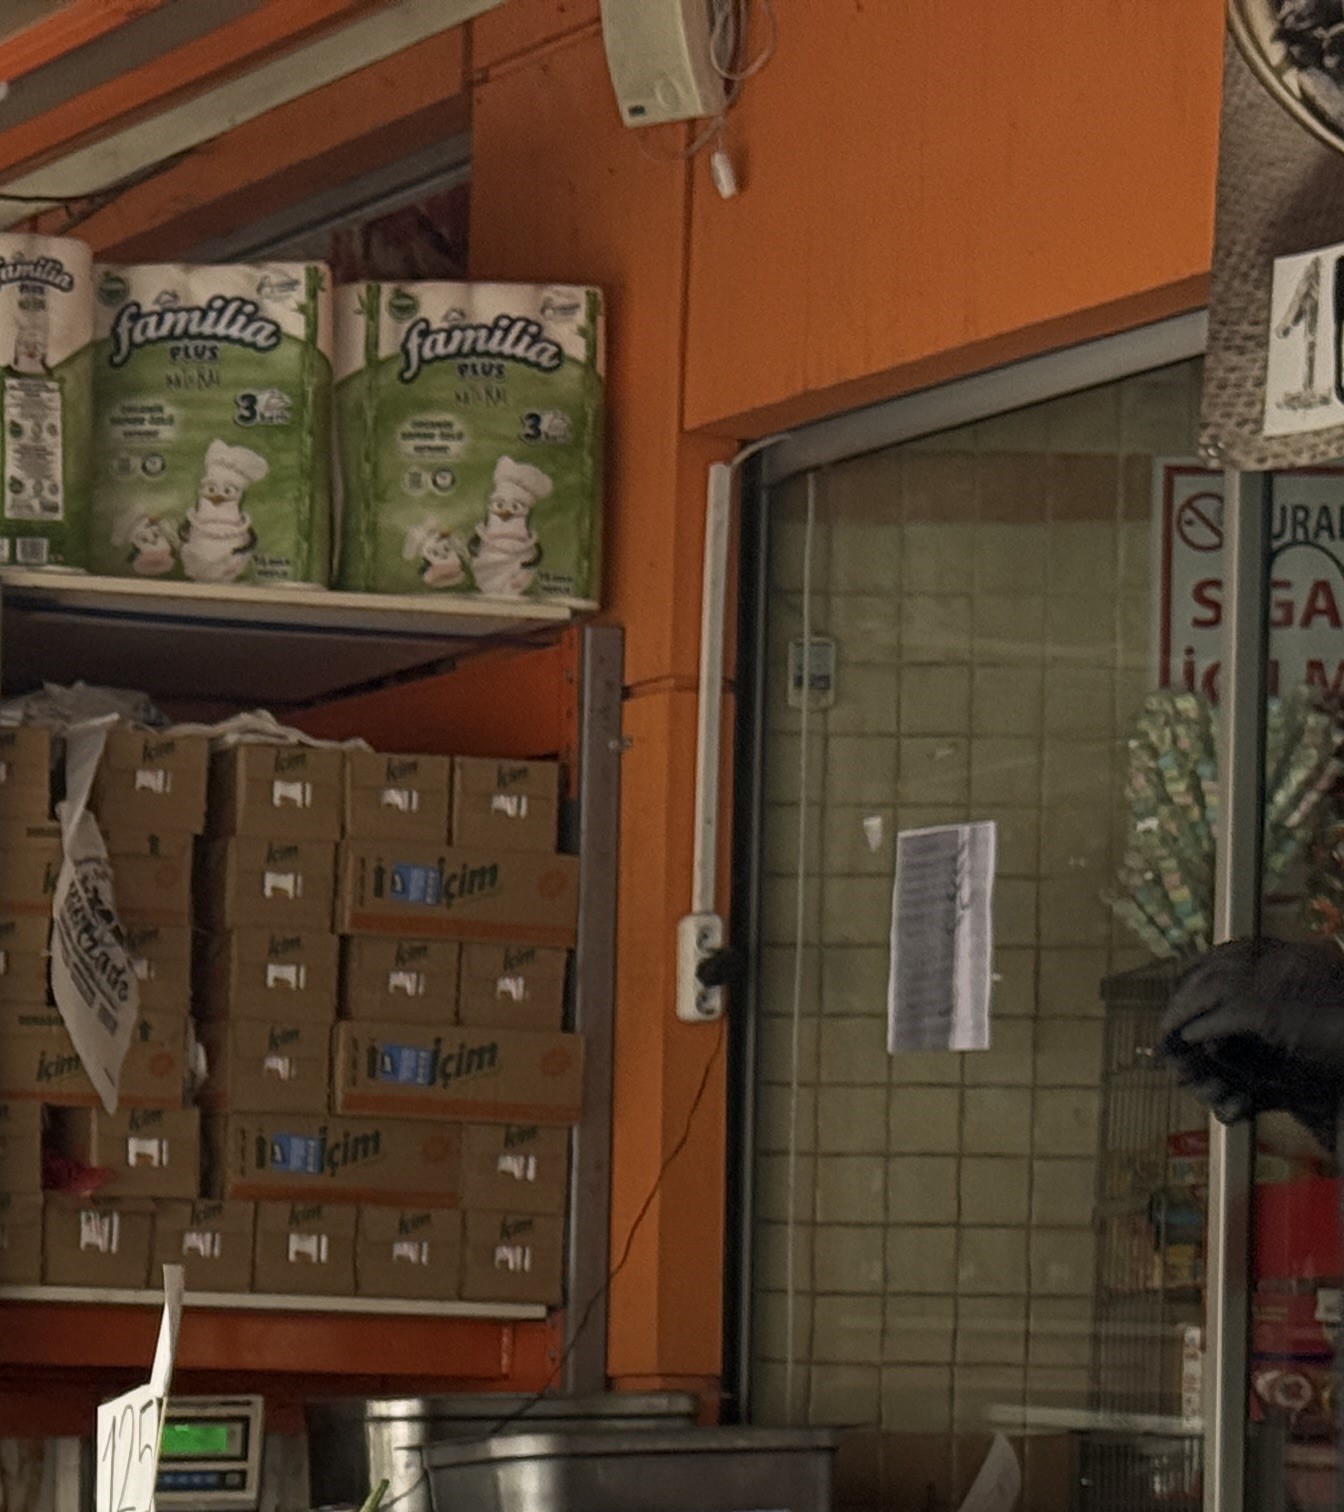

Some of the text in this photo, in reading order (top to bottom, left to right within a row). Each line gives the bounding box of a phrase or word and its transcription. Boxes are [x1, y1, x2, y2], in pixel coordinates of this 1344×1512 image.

[110, 294, 282, 369] familia
[169, 344, 221, 362] PLUS
[398, 312, 565, 385] familia
[456, 362, 508, 379] PLUS
[427, 1036, 499, 1089] İçim
[318, 1124, 382, 1179] İçim
